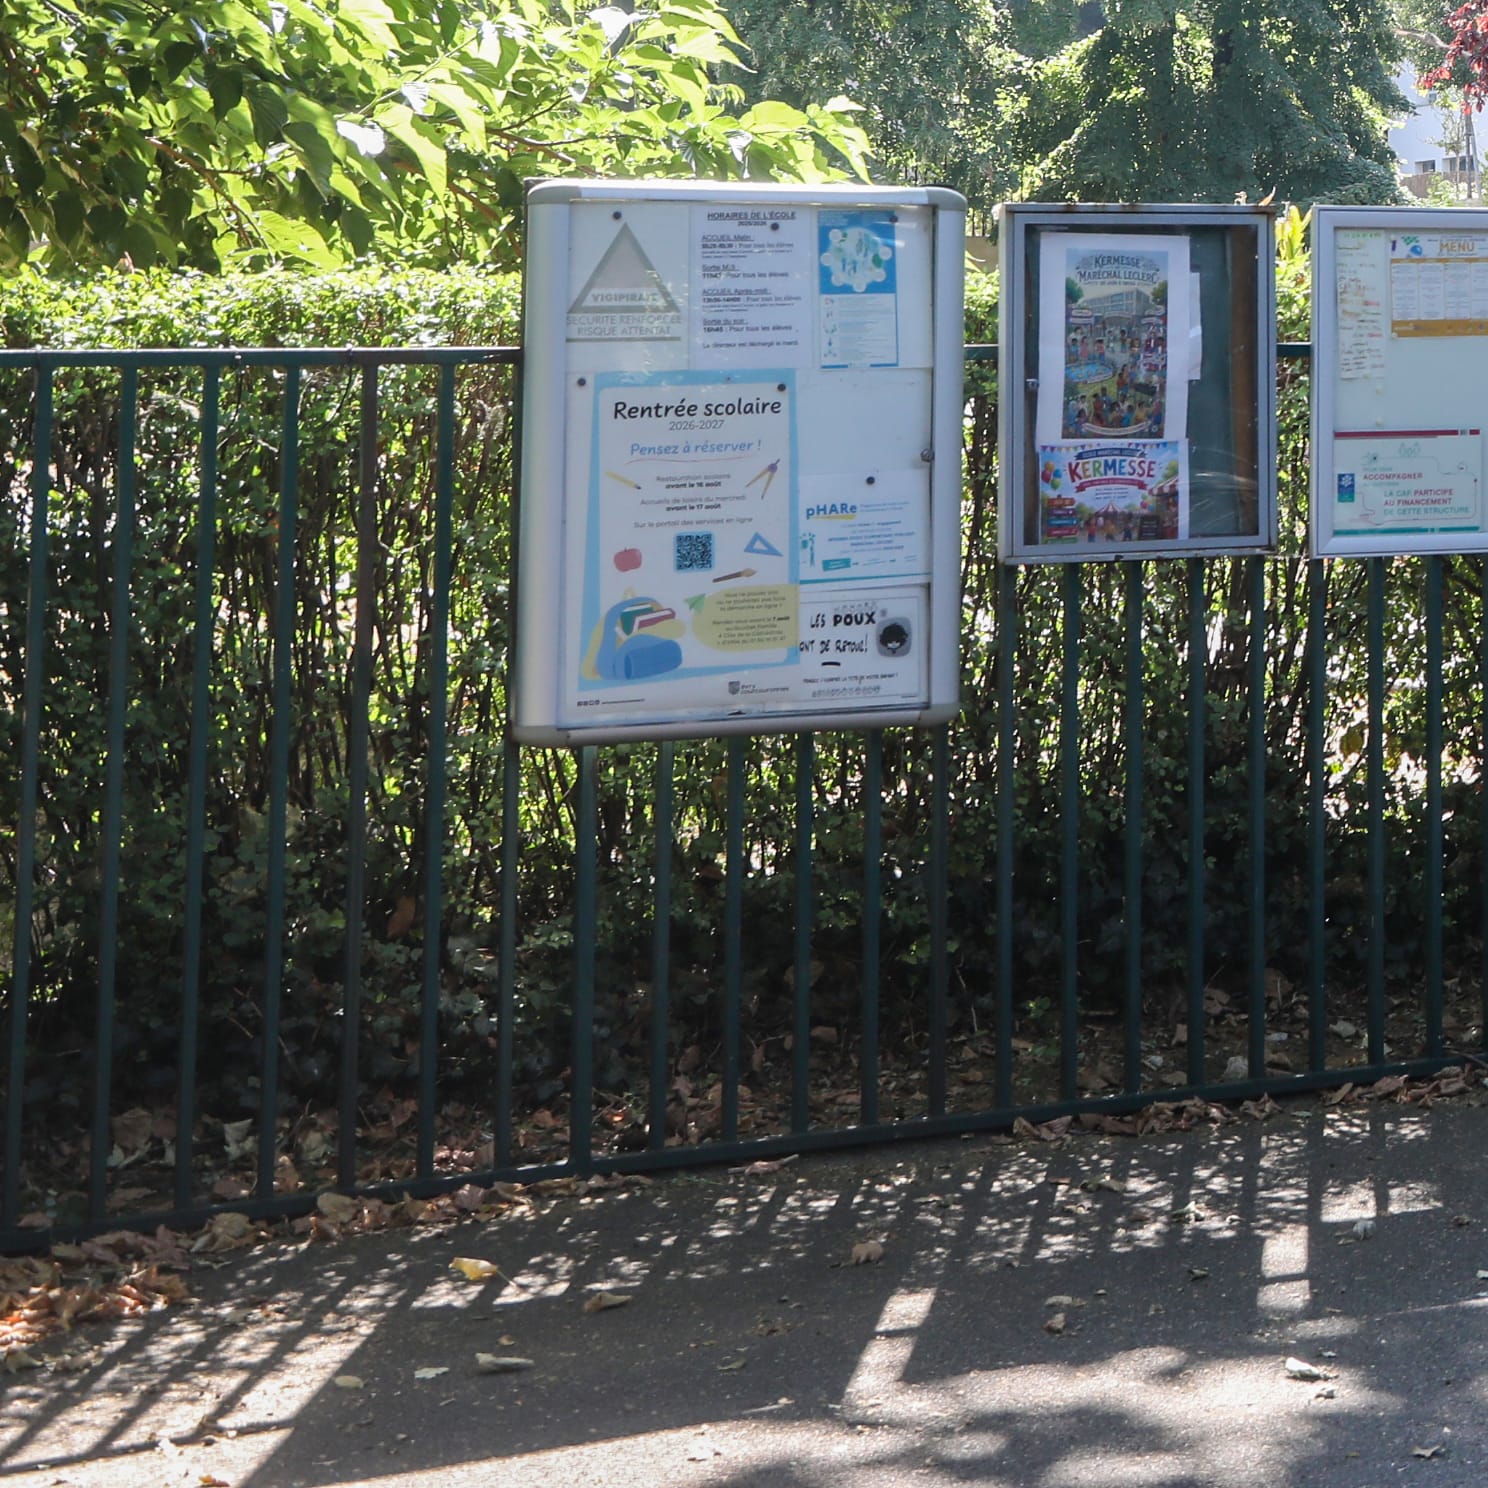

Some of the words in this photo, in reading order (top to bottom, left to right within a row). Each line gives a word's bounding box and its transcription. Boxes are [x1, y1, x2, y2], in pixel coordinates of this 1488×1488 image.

[707, 211, 749, 220] HORAIRES
[751, 211, 761, 220] DE
[763, 210, 796, 219] L'ÉCOLE
[1440, 241, 1476, 253] MENU
[1094, 253, 1141, 269] KERMESSE
[1124, 269, 1158, 284] LECLERC
[577, 327, 617, 336] RISQUE
[613, 398, 698, 419] Rentrée
[703, 397, 782, 417] scolaire
[668, 420, 725, 431] 2026-2027
[630, 442, 679, 456] Pensez
[682, 441, 690, 453] à
[694, 440, 754, 453] réserver
[1068, 458, 1157, 483] KERMESSE
[1363, 472, 1424, 481] ACCOMPAGNER
[1384, 490, 1395, 498] LA
[1413, 488, 1454, 496] PARTICIPE
[1383, 499, 1395, 507] AU
[1397, 497, 1453, 506] FINANCEMENT
[806, 503, 857, 520] pHARe
[1396, 507, 1422, 515] CETTE
[810, 613, 826, 628] LES
[833, 611, 876, 627] POUX
[800, 639, 815, 652] ONT
[820, 639, 831, 654] DE
